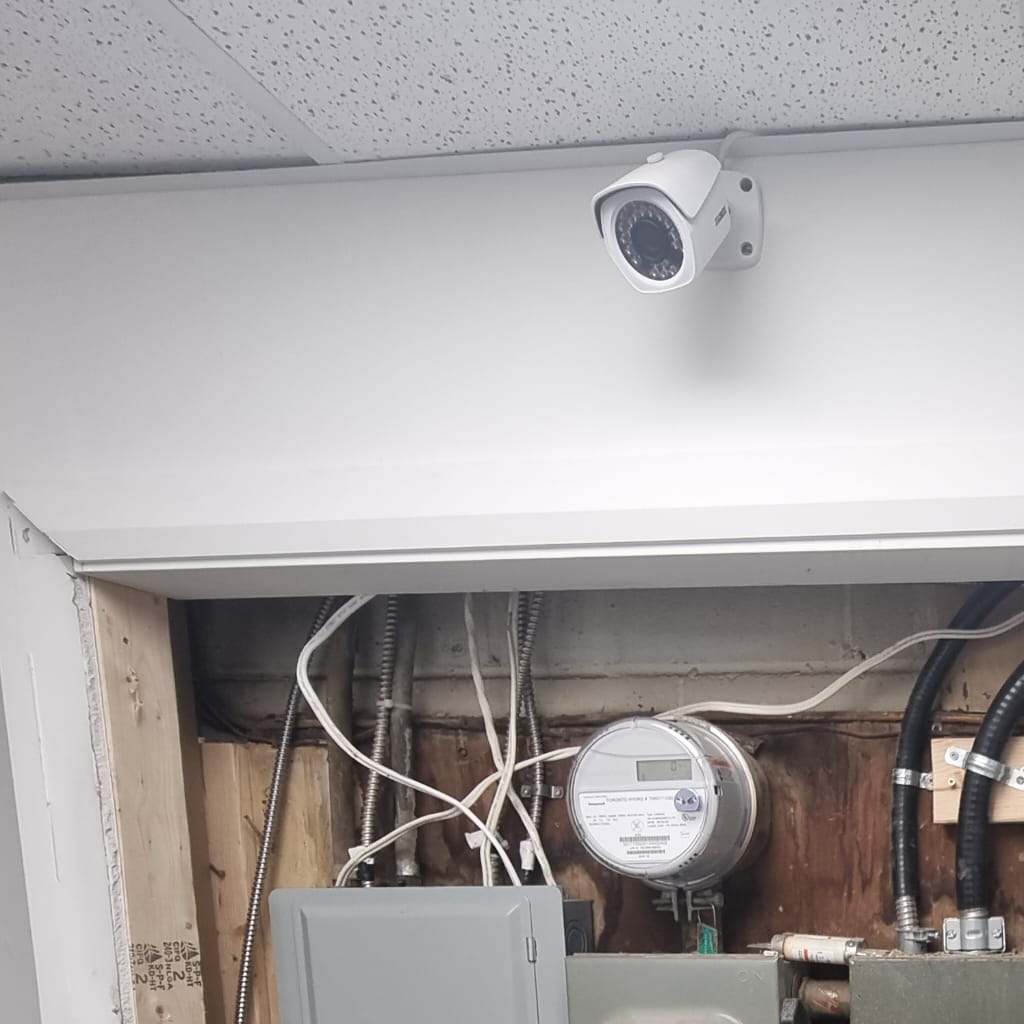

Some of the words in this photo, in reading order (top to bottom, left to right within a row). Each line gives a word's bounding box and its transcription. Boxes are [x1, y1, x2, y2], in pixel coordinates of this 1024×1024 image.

[135, 973, 148, 985] 2
[155, 964, 165, 990] S-P-F
[173, 970, 185, 982] 2
